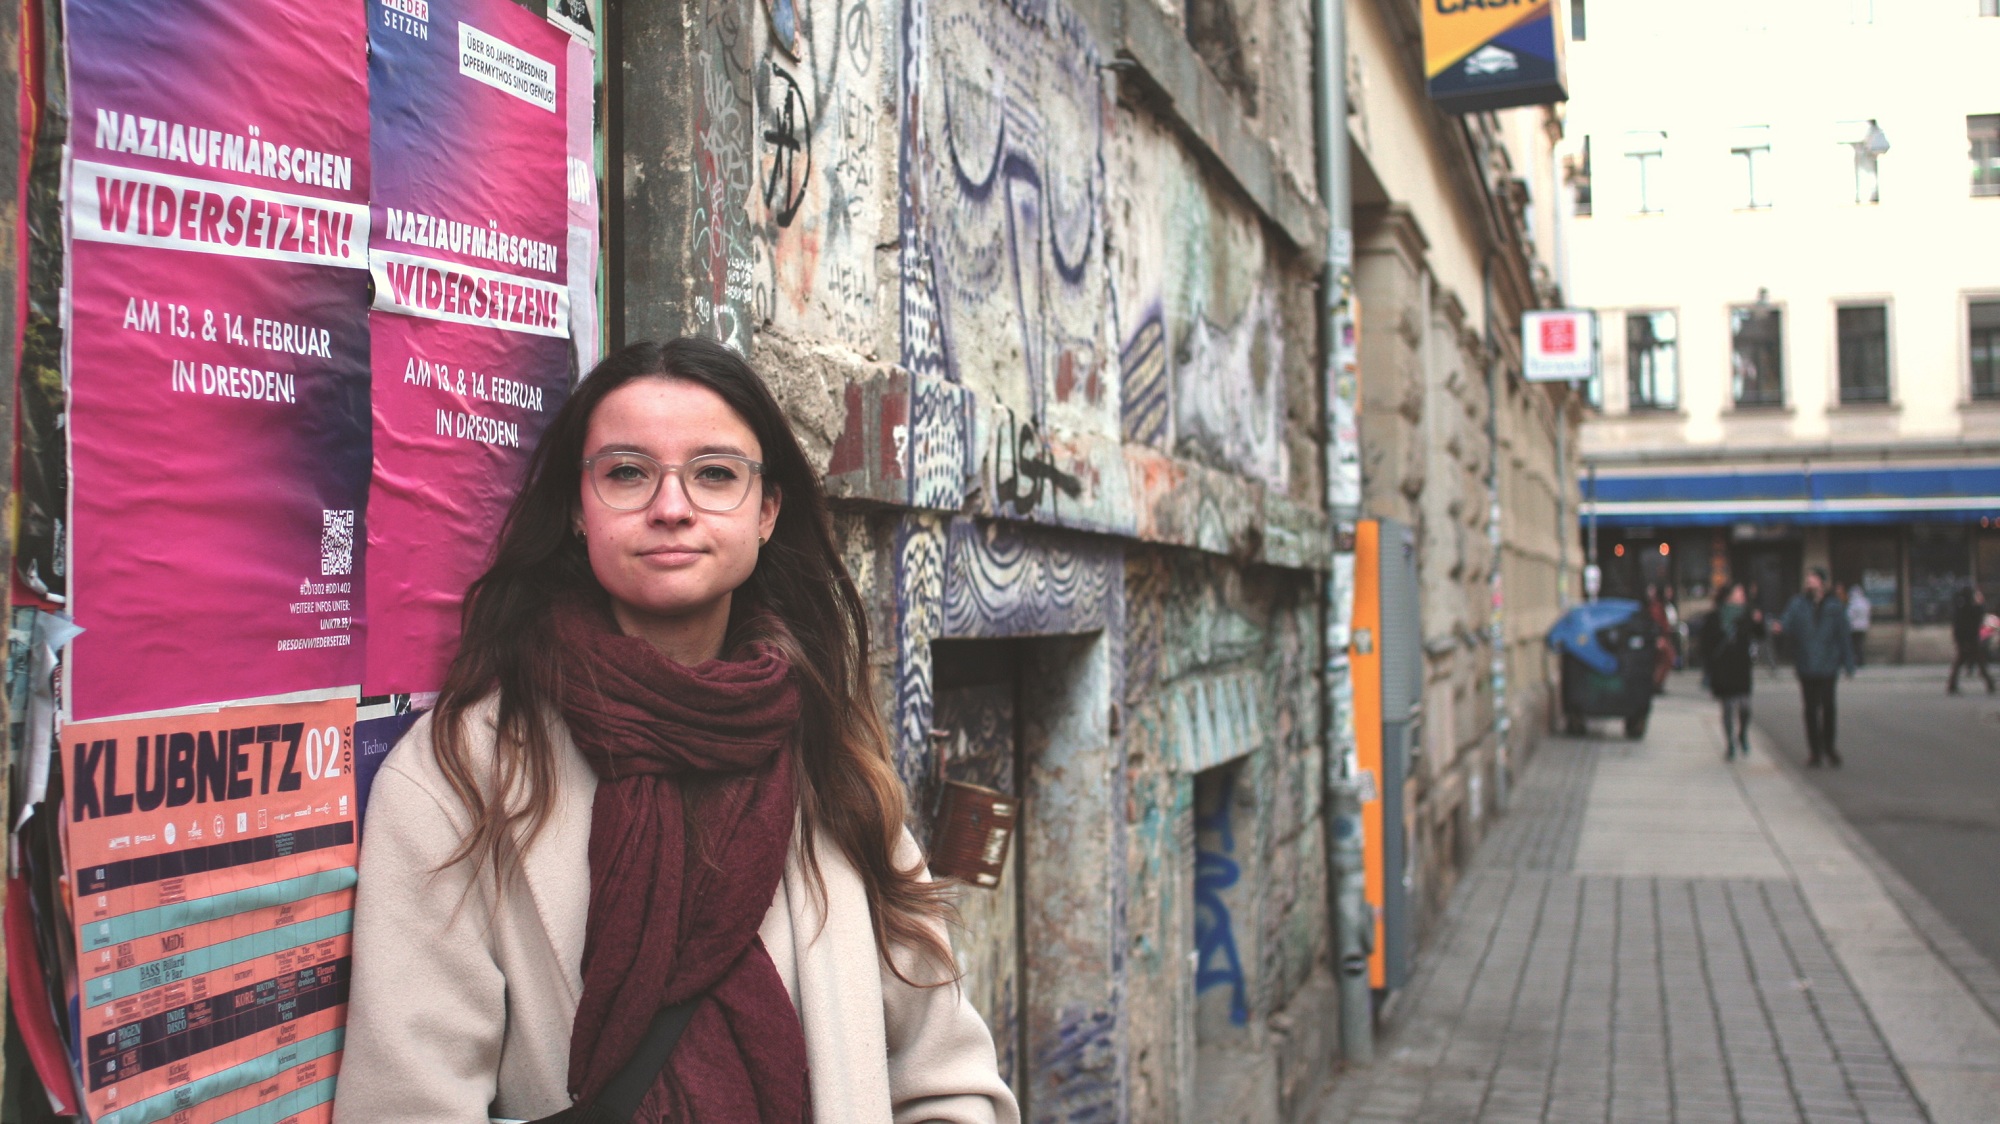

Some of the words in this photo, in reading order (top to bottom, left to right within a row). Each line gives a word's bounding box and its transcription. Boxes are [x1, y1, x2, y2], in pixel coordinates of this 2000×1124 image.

[384, 10, 428, 40] SETZEN
[462, 54, 512, 86] OPFERMYTHOS
[514, 75, 528, 92] SIND
[530, 83, 554, 104] GENUG!
[466, 32, 484, 54] ÜBER
[486, 44, 494, 59] 80
[496, 49, 515, 69] JAHRE
[516, 57, 548, 84] DRESDNER
[95, 108, 352, 190] NAZIAUFMÄRSCHEN
[96, 176, 353, 258] WIDERSETZEN!
[386, 207, 558, 274] NAZIAUFMÄRSCHEN
[386, 262, 558, 330] WIDERSETZEN!
[123, 297, 160, 334] AM
[168, 303, 196, 339] 13.
[202, 310, 217, 342] &
[224, 312, 248, 347] 14.
[254, 317, 332, 358] FEBRUAR
[172, 360, 196, 393] IN
[202, 363, 296, 404] DRESDEN!
[404, 357, 431, 388] AM
[434, 363, 454, 393] 13.
[457, 368, 467, 396] &
[472, 372, 488, 400] 14.
[492, 376, 543, 412] FEBRUAR
[436, 408, 452, 436] IN
[456, 413, 519, 448] DRESDEN!
[290, 603, 314, 614] WEITERE
[315, 602, 332, 612] INFOS
[333, 600, 350, 612] UNTER:
[326, 582, 351, 594] #DD1402
[278, 634, 350, 652] DRESDENWIEDERSETZEN
[320, 616, 352, 630] LINKTR.EE/
[344, 725, 352, 774] 2026
[362, 739, 388, 756] Techno
[74, 722, 304, 822] KLUBNETZ
[306, 726, 340, 780] 02
[167, 1008, 185, 1023] INDIE
[235, 991, 254, 1008] KORE
[167, 1019, 186, 1034] DISCO
